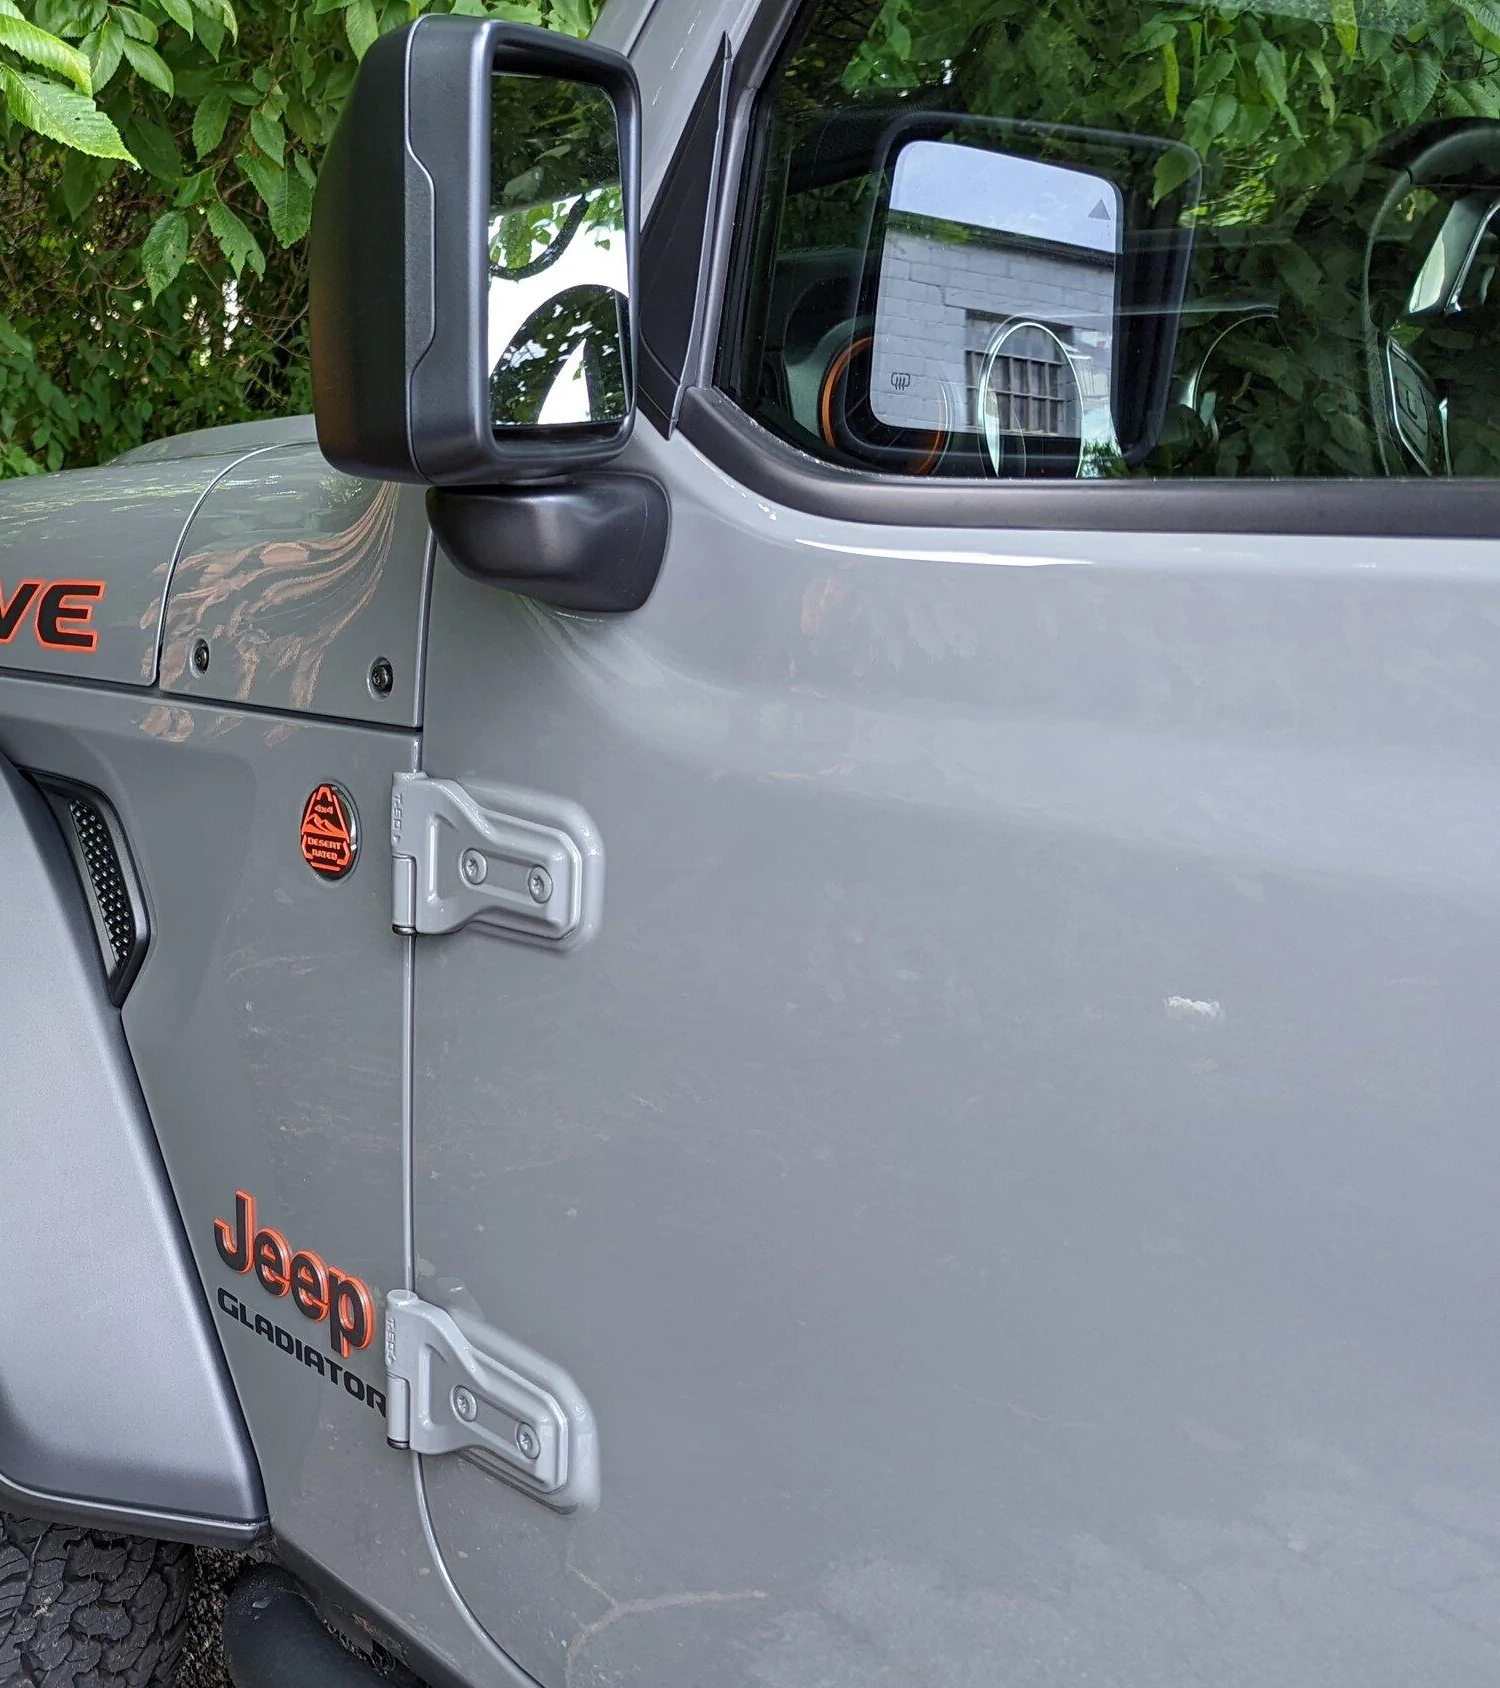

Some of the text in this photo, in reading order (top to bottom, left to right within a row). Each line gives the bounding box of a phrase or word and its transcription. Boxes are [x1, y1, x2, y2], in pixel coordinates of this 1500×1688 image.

[314, 804, 334, 815] 4x4
[307, 836, 342, 850] DESERT
[311, 848, 338, 861] RATED
[213, 1189, 375, 1359] Jeep
[217, 1286, 387, 1418] GLADIATOR
